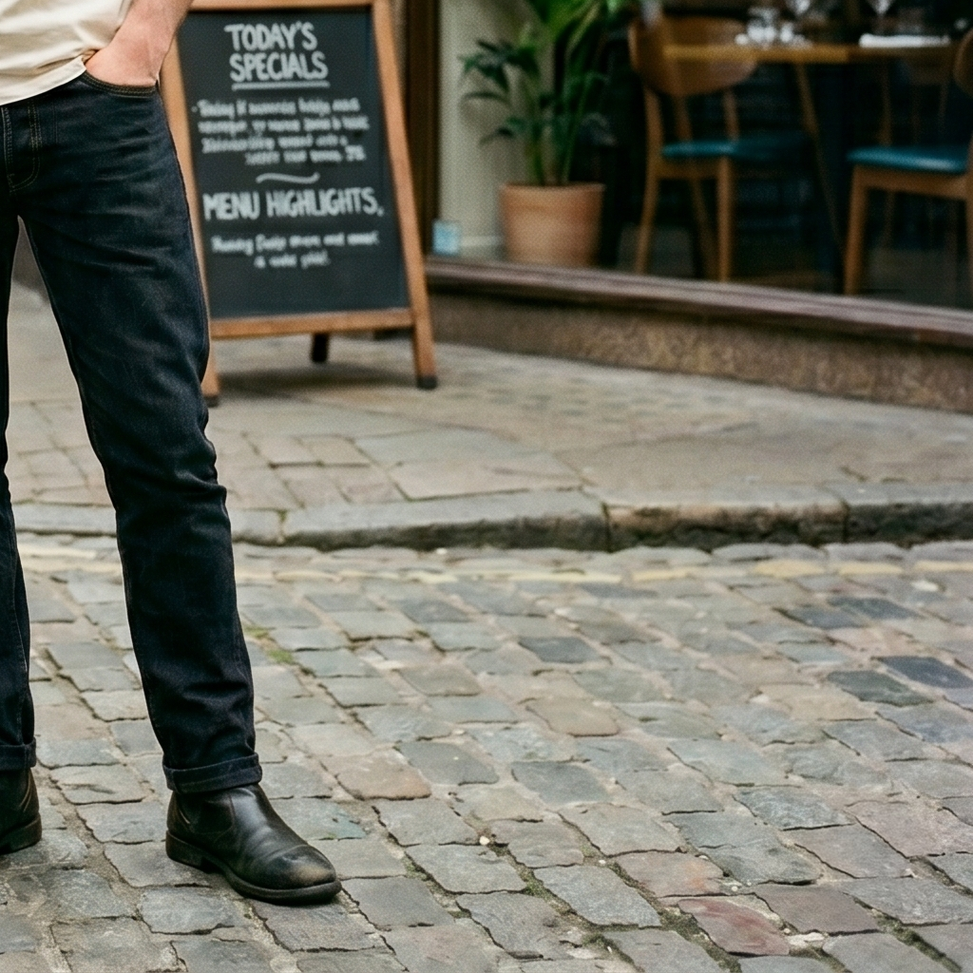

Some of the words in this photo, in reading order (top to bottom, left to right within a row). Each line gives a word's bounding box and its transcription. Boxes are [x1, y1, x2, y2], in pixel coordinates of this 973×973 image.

[224, 21, 318, 51] TODAY'S
[229, 52, 329, 82] SPECIALS
[202, 191, 260, 221] MENU
